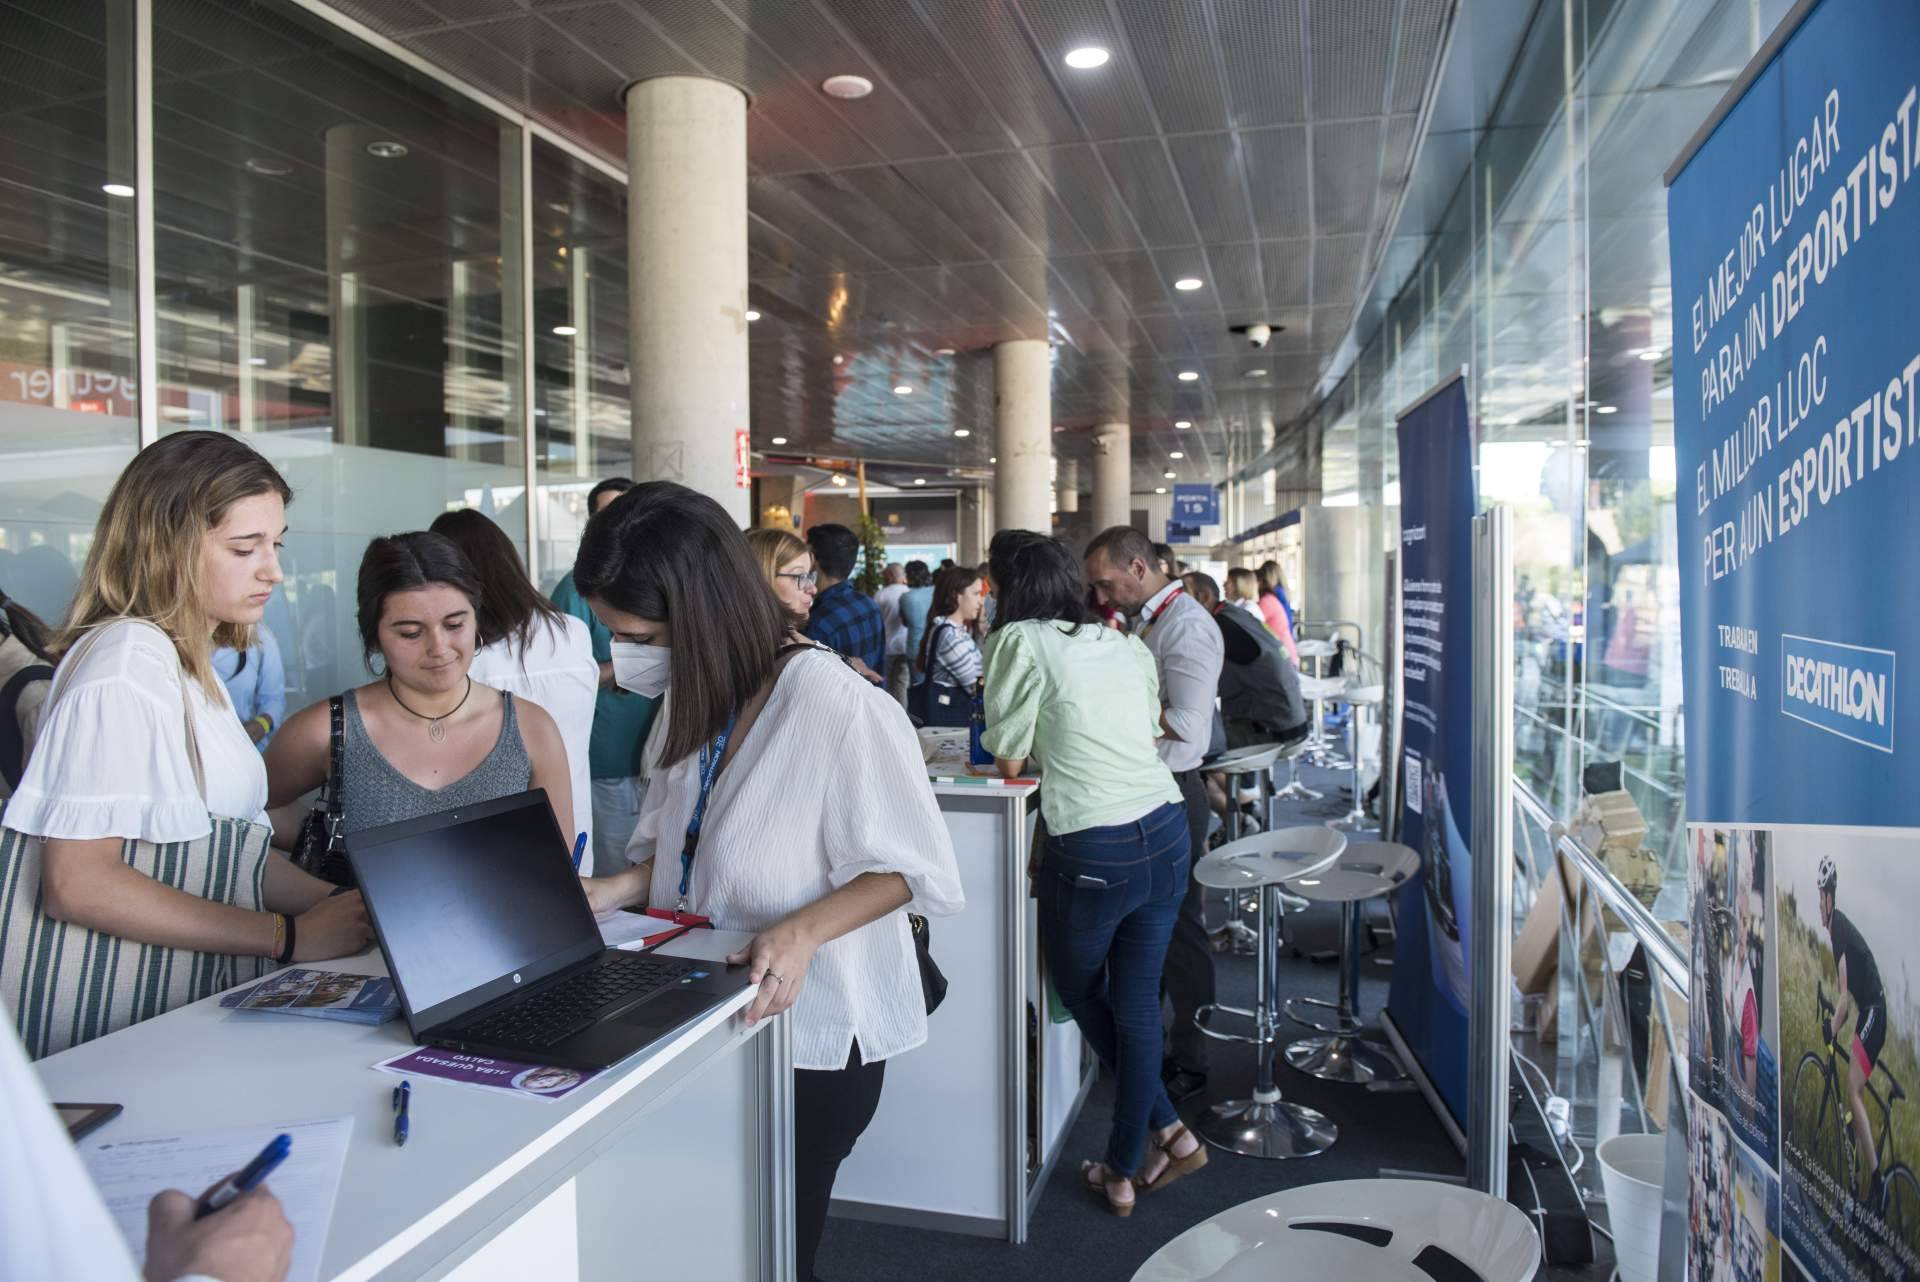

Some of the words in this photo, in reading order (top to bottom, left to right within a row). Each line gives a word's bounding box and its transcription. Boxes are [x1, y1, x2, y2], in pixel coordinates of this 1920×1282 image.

[1692, 294, 1707, 354] EL
[1708, 202, 1766, 329] MEJOR
[1770, 88, 1841, 245] LUGAR
[1702, 332, 1744, 421] PARA
[1745, 291, 1766, 371] UN
[1772, 84, 1920, 339] DEPORTIST
[1697, 460, 1710, 516] EL
[1712, 395, 1772, 500] MILLOR
[1777, 335, 1827, 442] LLOC
[1703, 521, 1737, 587] PER
[1747, 484, 1773, 555] UN
[1778, 353, 1920, 536] ESPORTIST
[1786, 654, 1886, 727] DECATHLON
[415, 1055, 474, 1070] QUESADA
[452, 1054, 495, 1065] CALVO
[475, 1066, 511, 1075] ALBA
